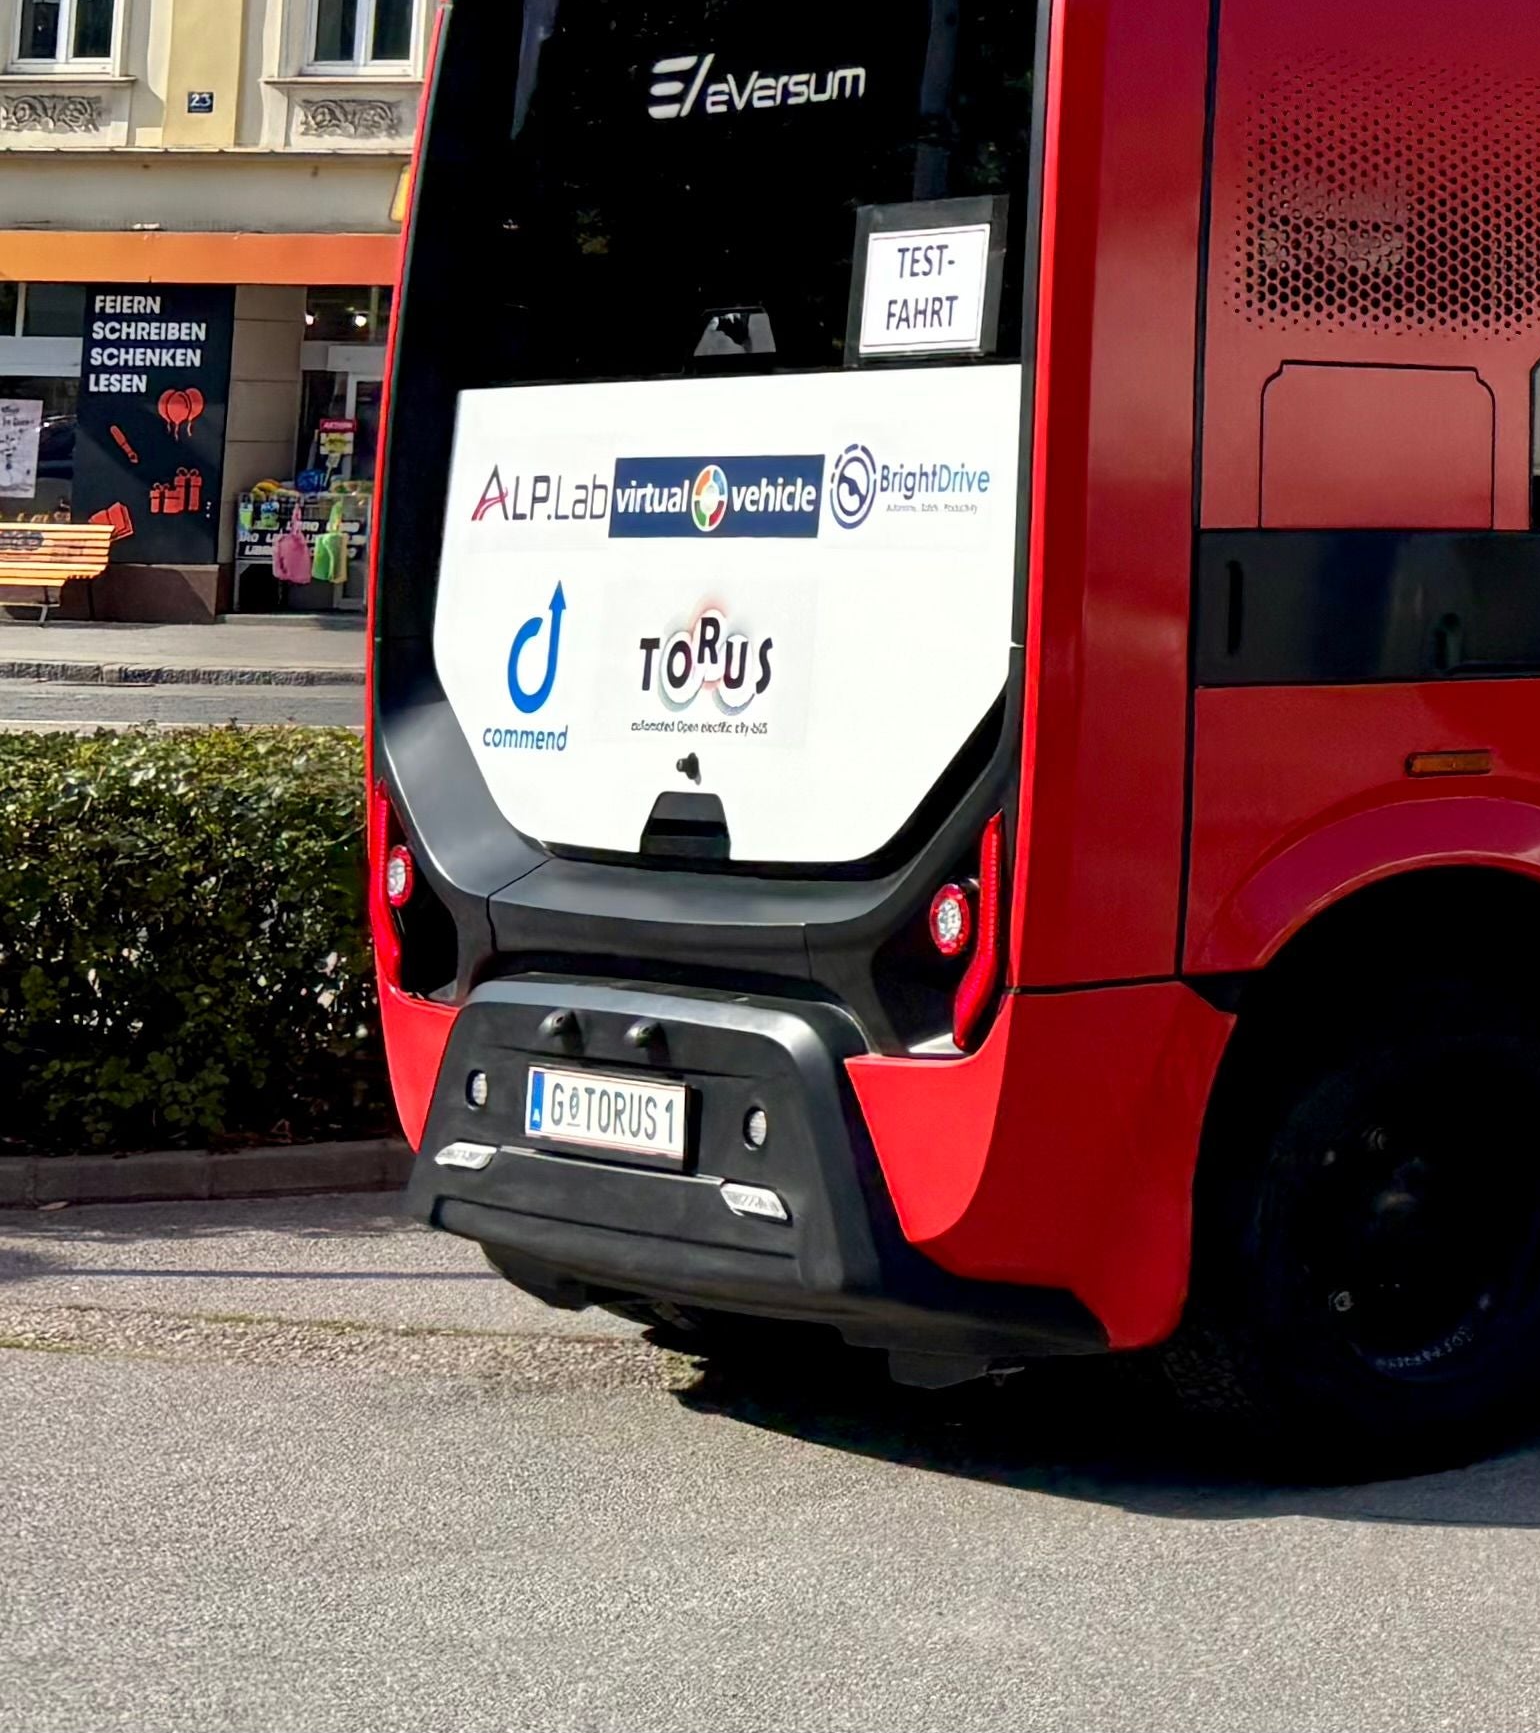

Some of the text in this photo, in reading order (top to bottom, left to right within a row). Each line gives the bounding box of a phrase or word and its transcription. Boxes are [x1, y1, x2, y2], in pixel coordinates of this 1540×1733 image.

[189, 93, 212, 107] 23
[705, 67, 866, 114] eVersum
[897, 244, 956, 279] TEST-
[94, 295, 161, 314] FEIERN
[886, 295, 959, 331] FAHRT
[92, 321, 207, 341] SCHREIBEN
[90, 347, 201, 367] SCHENKEN
[89, 373, 147, 393] LESEN
[470, 463, 990, 521] ALP.Lab virtual vehicle BrightDrive
[638, 616, 774, 695] TORUS
[482, 724, 569, 751] commend
